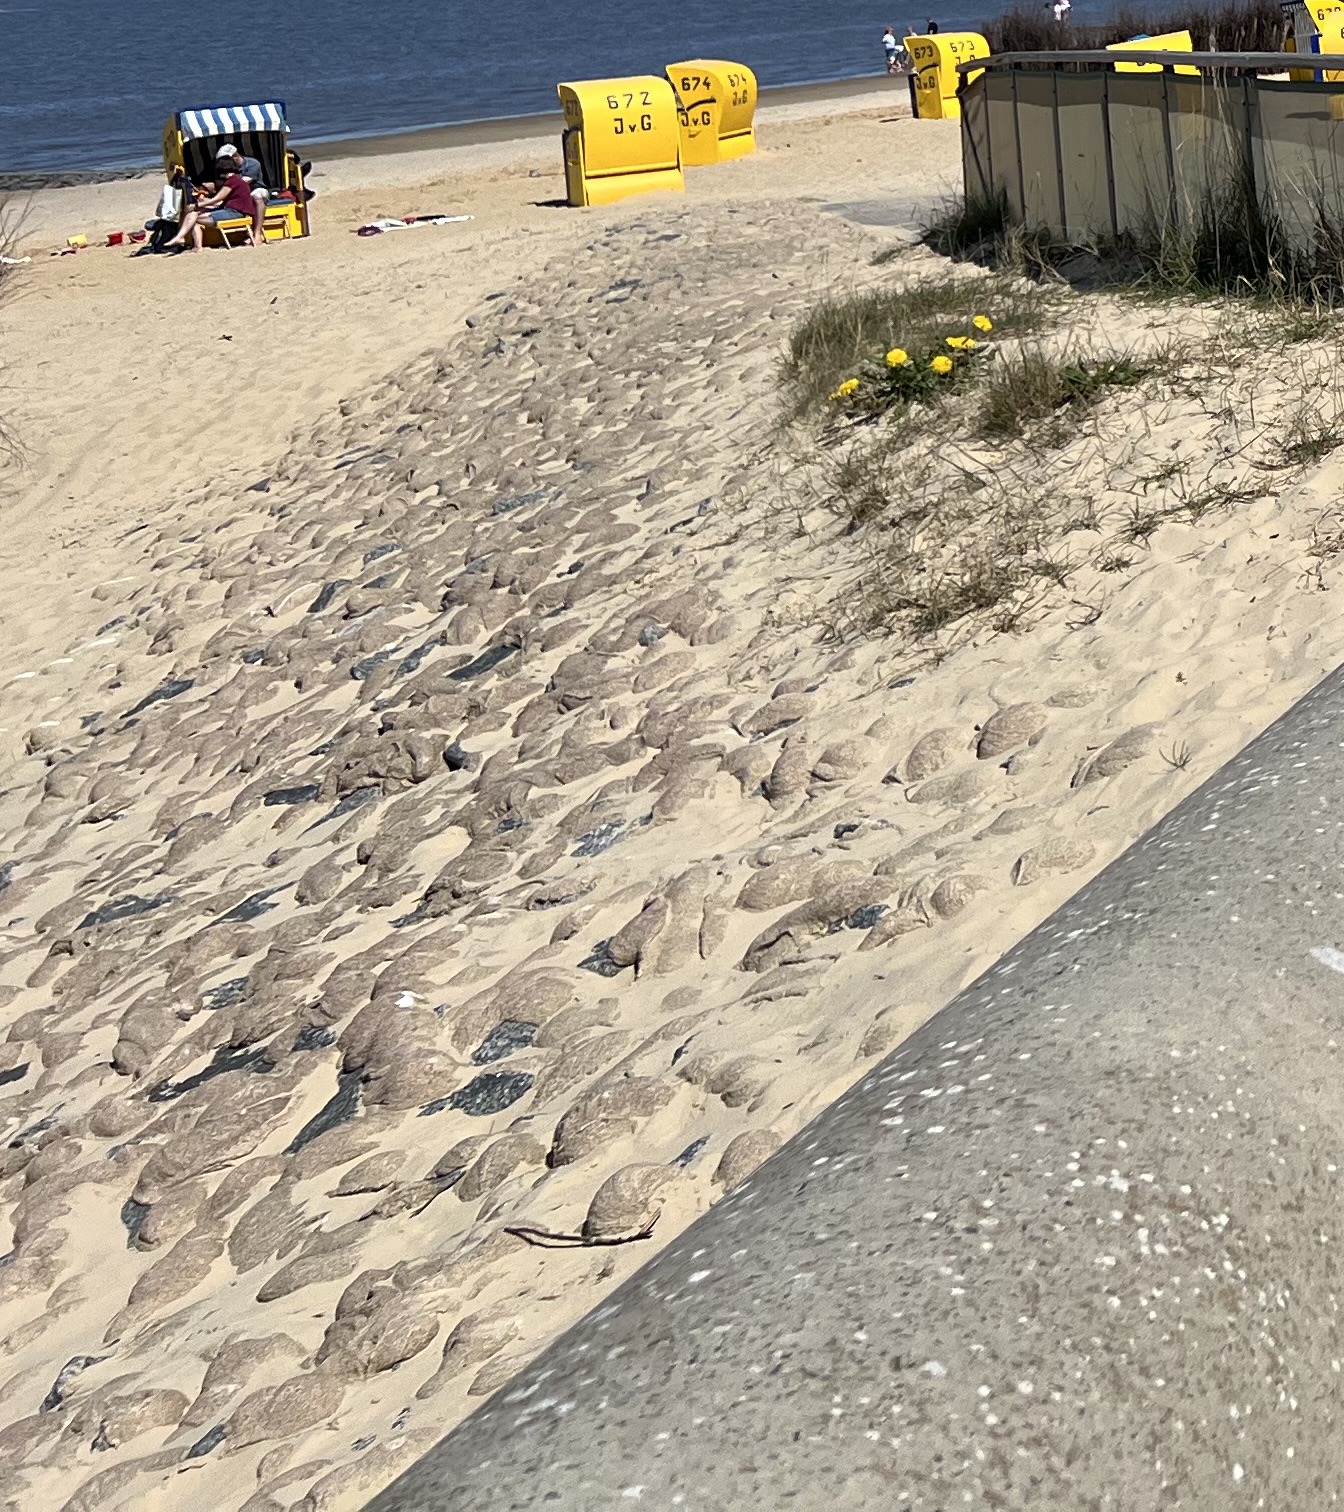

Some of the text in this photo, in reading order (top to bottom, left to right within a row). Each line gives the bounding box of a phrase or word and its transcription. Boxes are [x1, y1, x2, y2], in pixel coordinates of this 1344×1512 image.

[915, 46, 933, 58] 673
[682, 77, 712, 91] 674
[607, 92, 653, 109] 672
